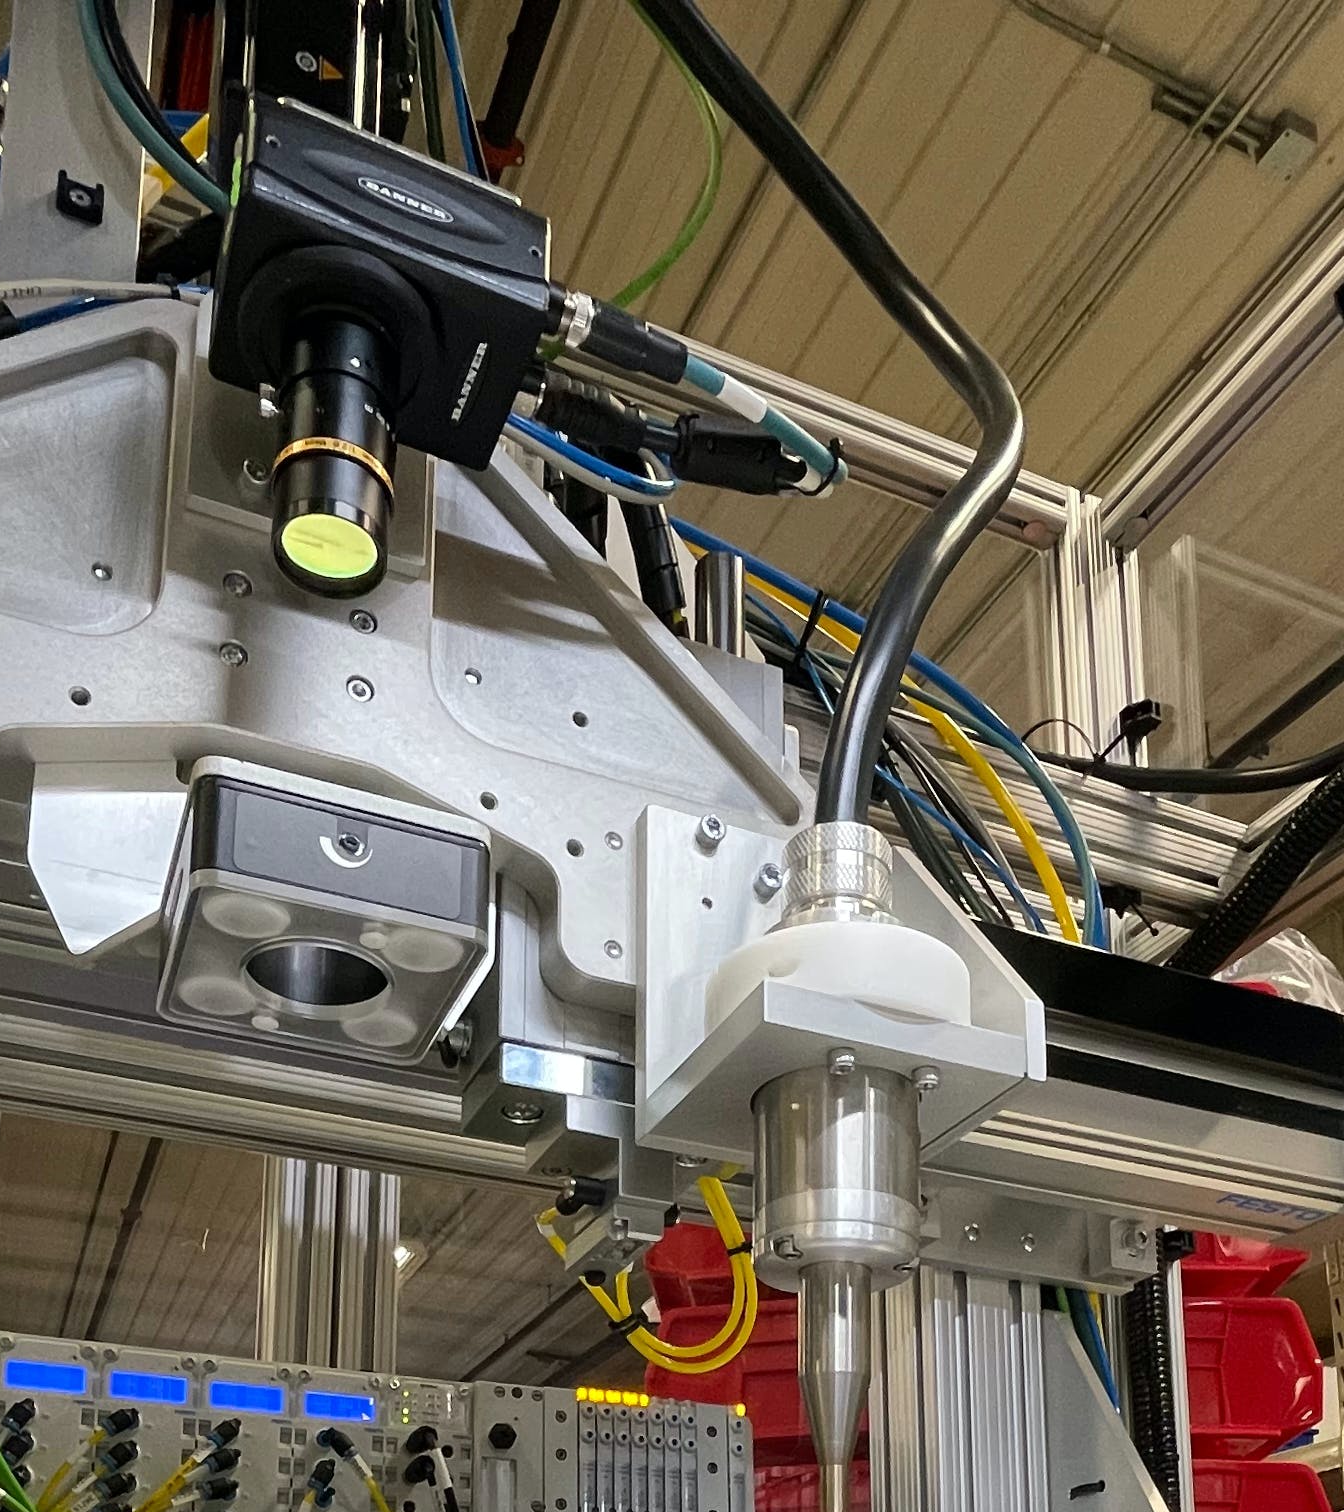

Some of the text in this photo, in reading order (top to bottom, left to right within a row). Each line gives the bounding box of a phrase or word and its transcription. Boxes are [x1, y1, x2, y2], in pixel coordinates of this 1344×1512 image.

[366, 181, 446, 219] BANNER
[451, 342, 488, 421] BANNER
[1216, 1191, 1327, 1220] FESTO
